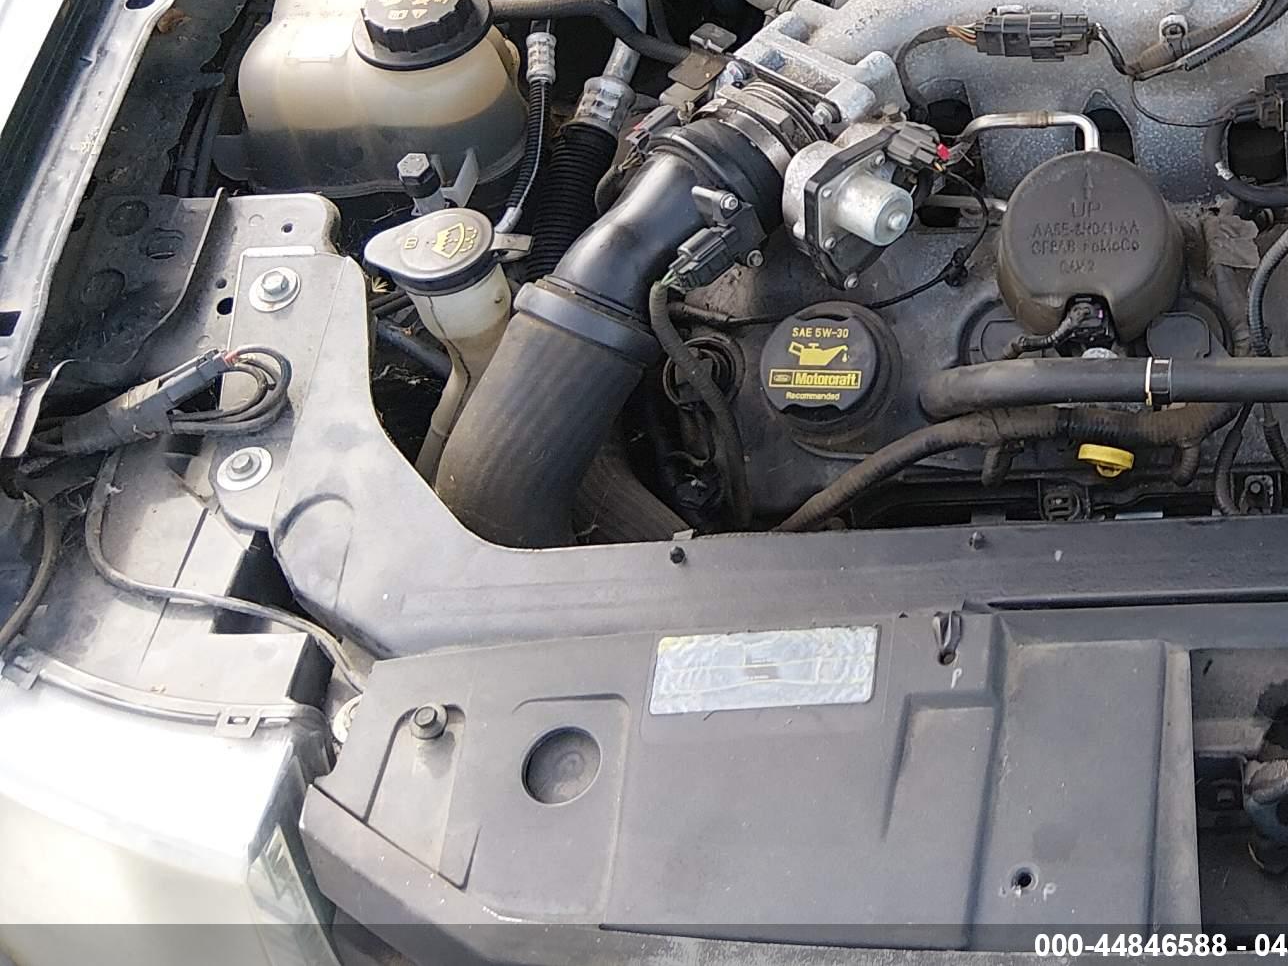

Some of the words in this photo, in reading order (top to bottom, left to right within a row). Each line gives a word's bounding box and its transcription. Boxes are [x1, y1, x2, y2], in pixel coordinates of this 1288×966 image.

[1071, 202, 1102, 218] UP
[792, 327, 812, 337] SAE
[815, 328, 849, 338] 5W-30
[795, 373, 857, 386] Motorcraft
[785, 391, 840, 401] Recommended
